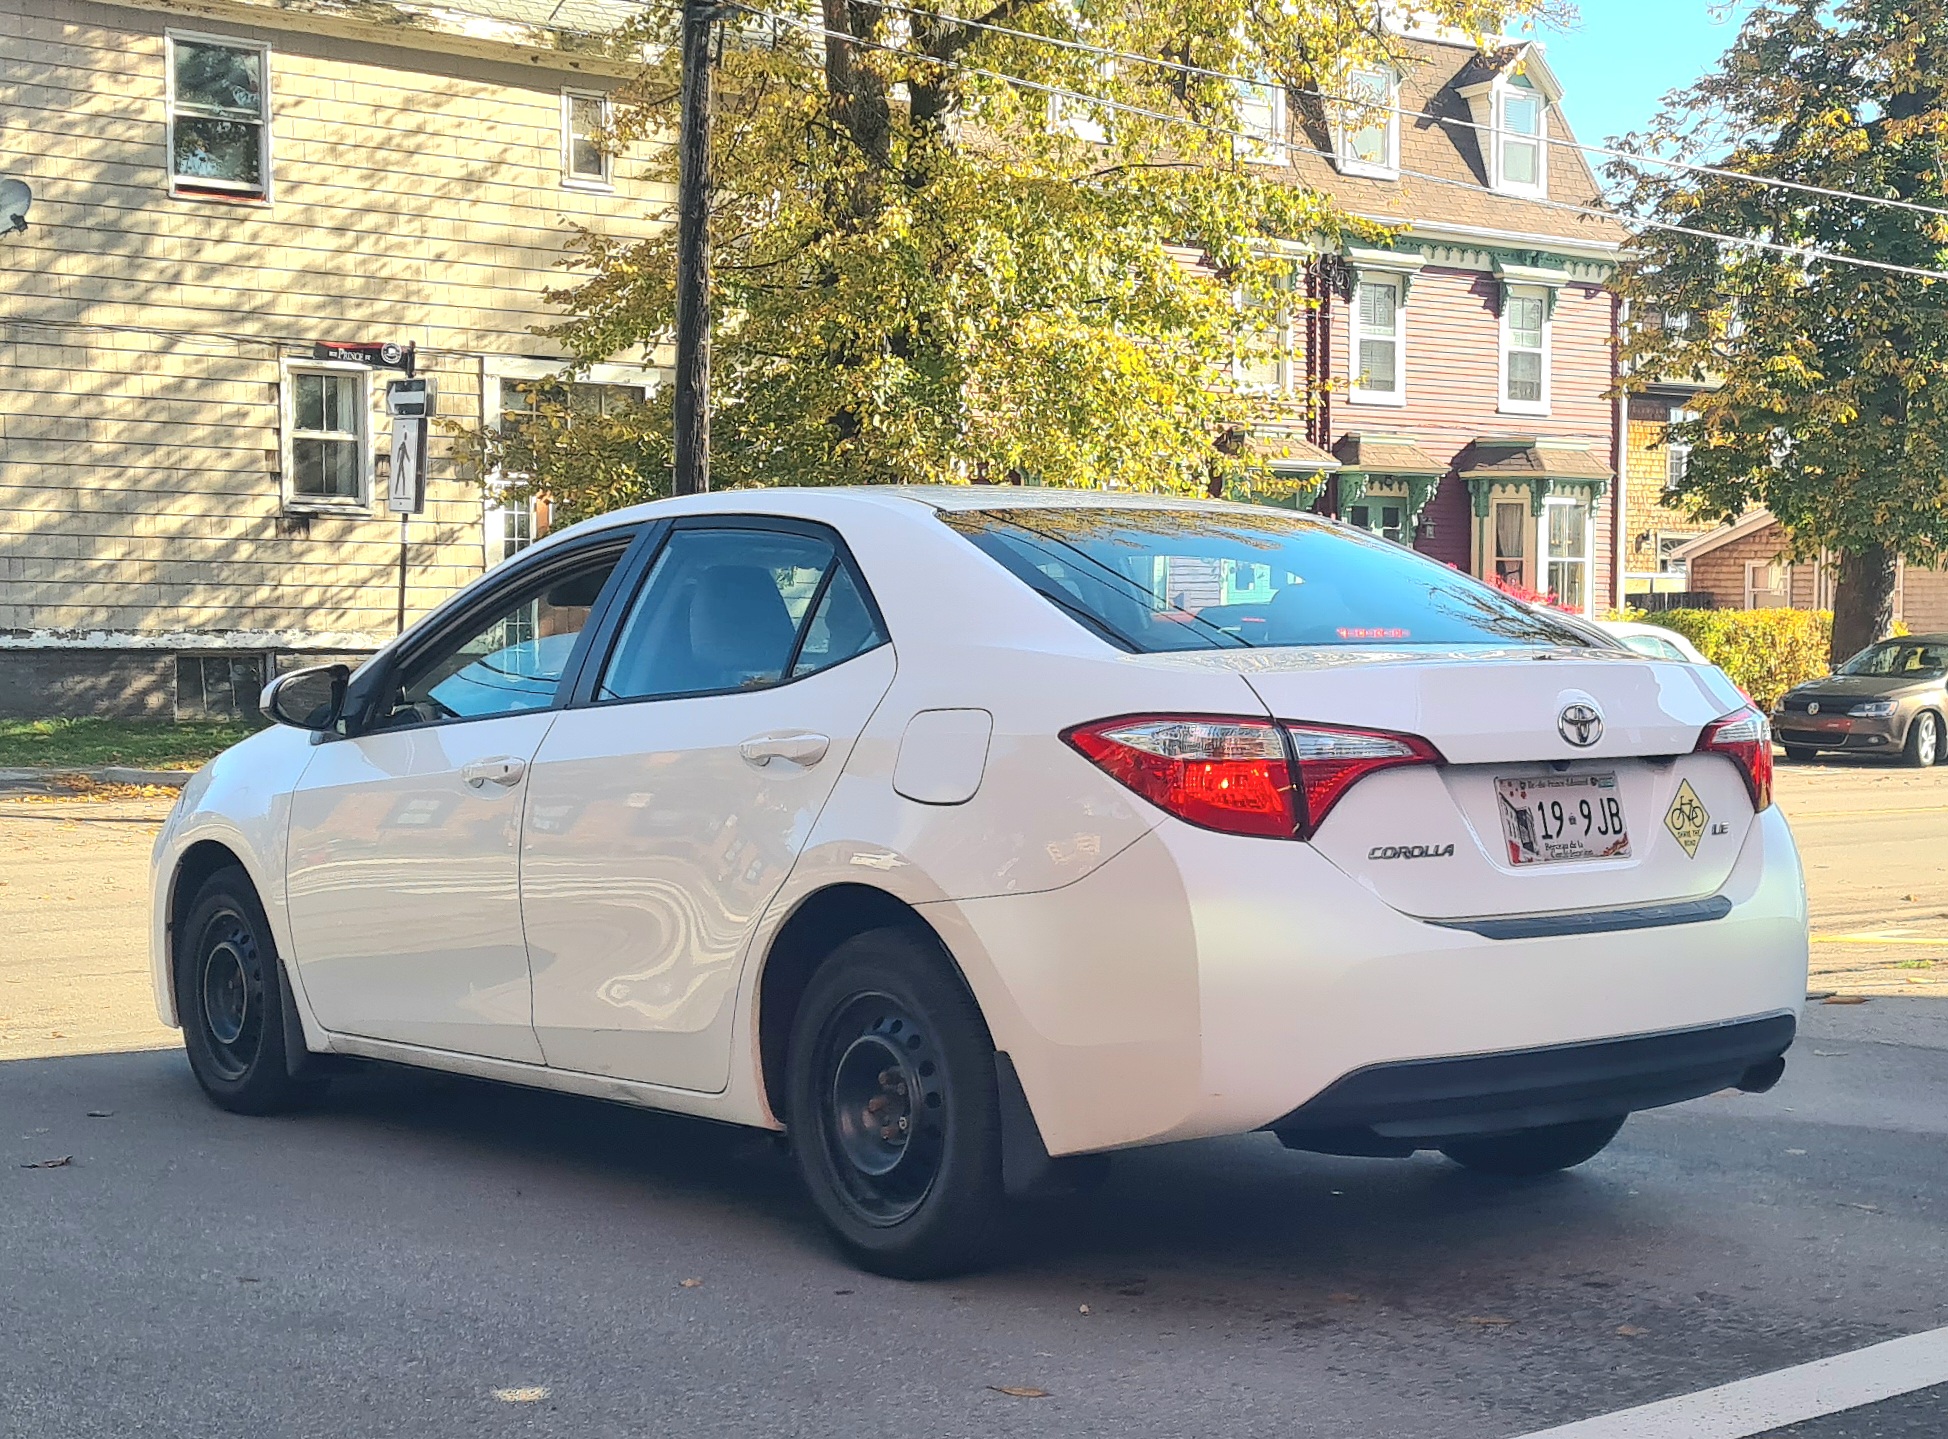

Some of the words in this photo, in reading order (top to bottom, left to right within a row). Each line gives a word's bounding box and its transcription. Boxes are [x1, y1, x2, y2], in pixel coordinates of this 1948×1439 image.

[1538, 801, 1564, 839] 19
[1579, 798, 1623, 836] 9JB
[1711, 821, 1729, 835] LE
[1367, 843, 1455, 860] COROLLA
